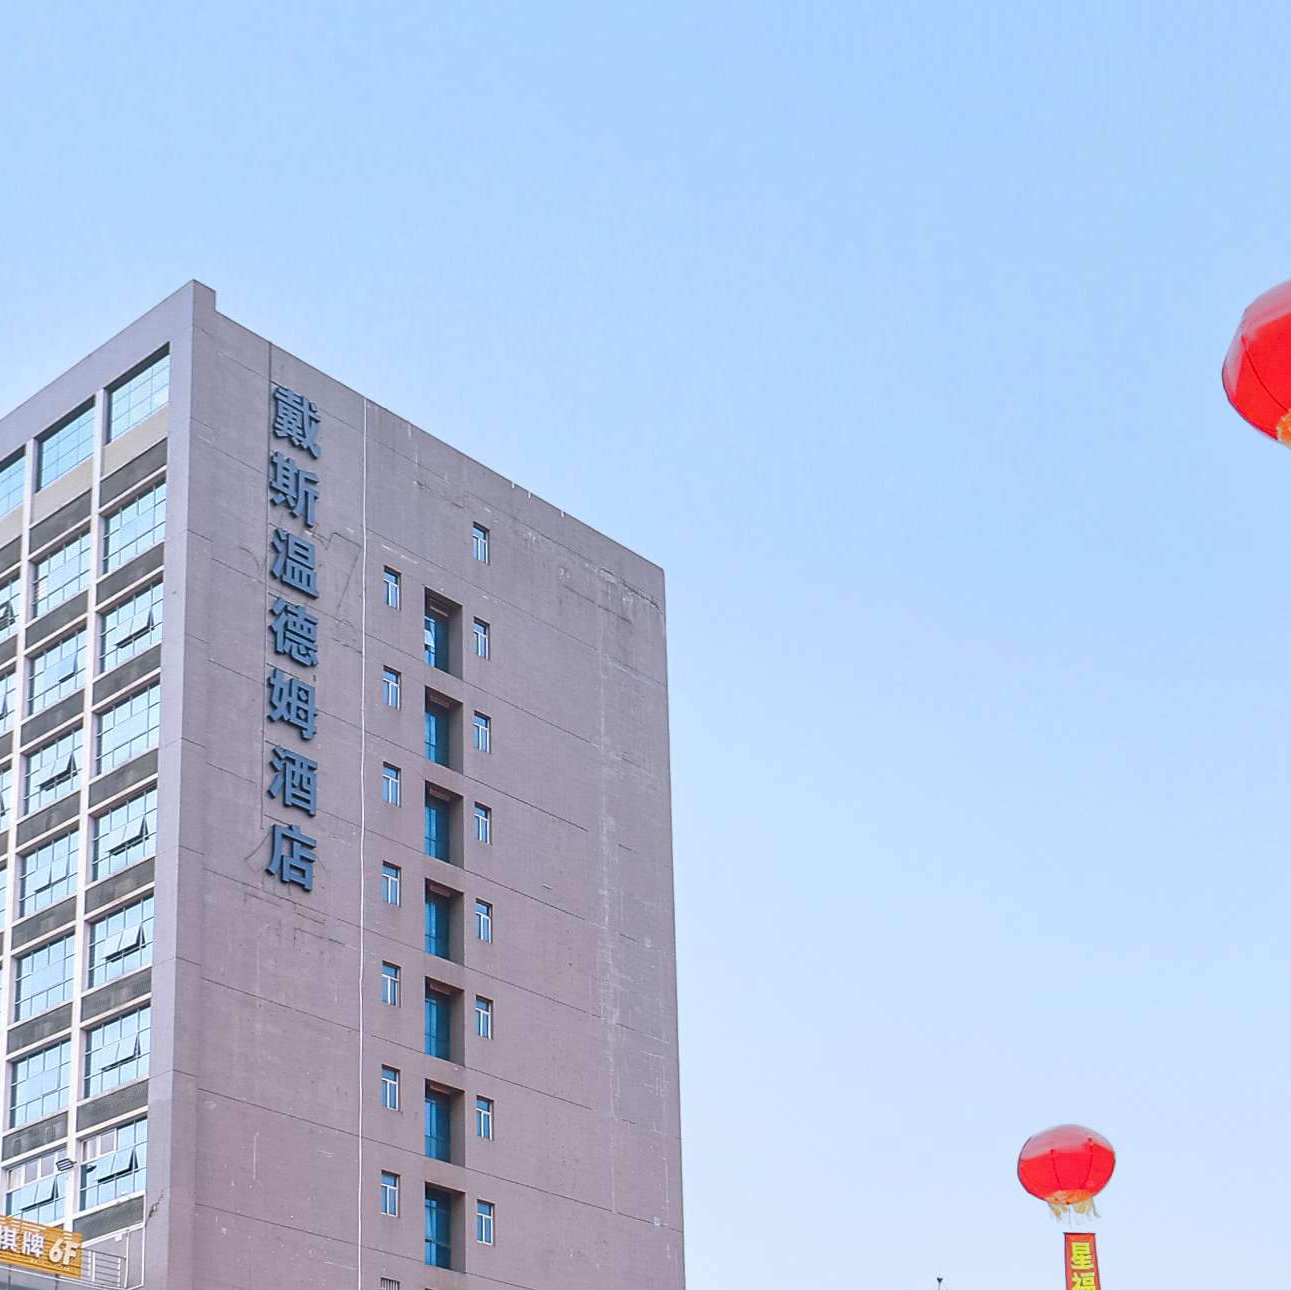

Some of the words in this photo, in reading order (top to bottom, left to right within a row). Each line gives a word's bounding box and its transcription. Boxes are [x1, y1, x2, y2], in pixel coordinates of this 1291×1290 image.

[267, 384, 322, 893] 戴斯温德姆酒店
[49, 1237, 82, 1265] 6F
